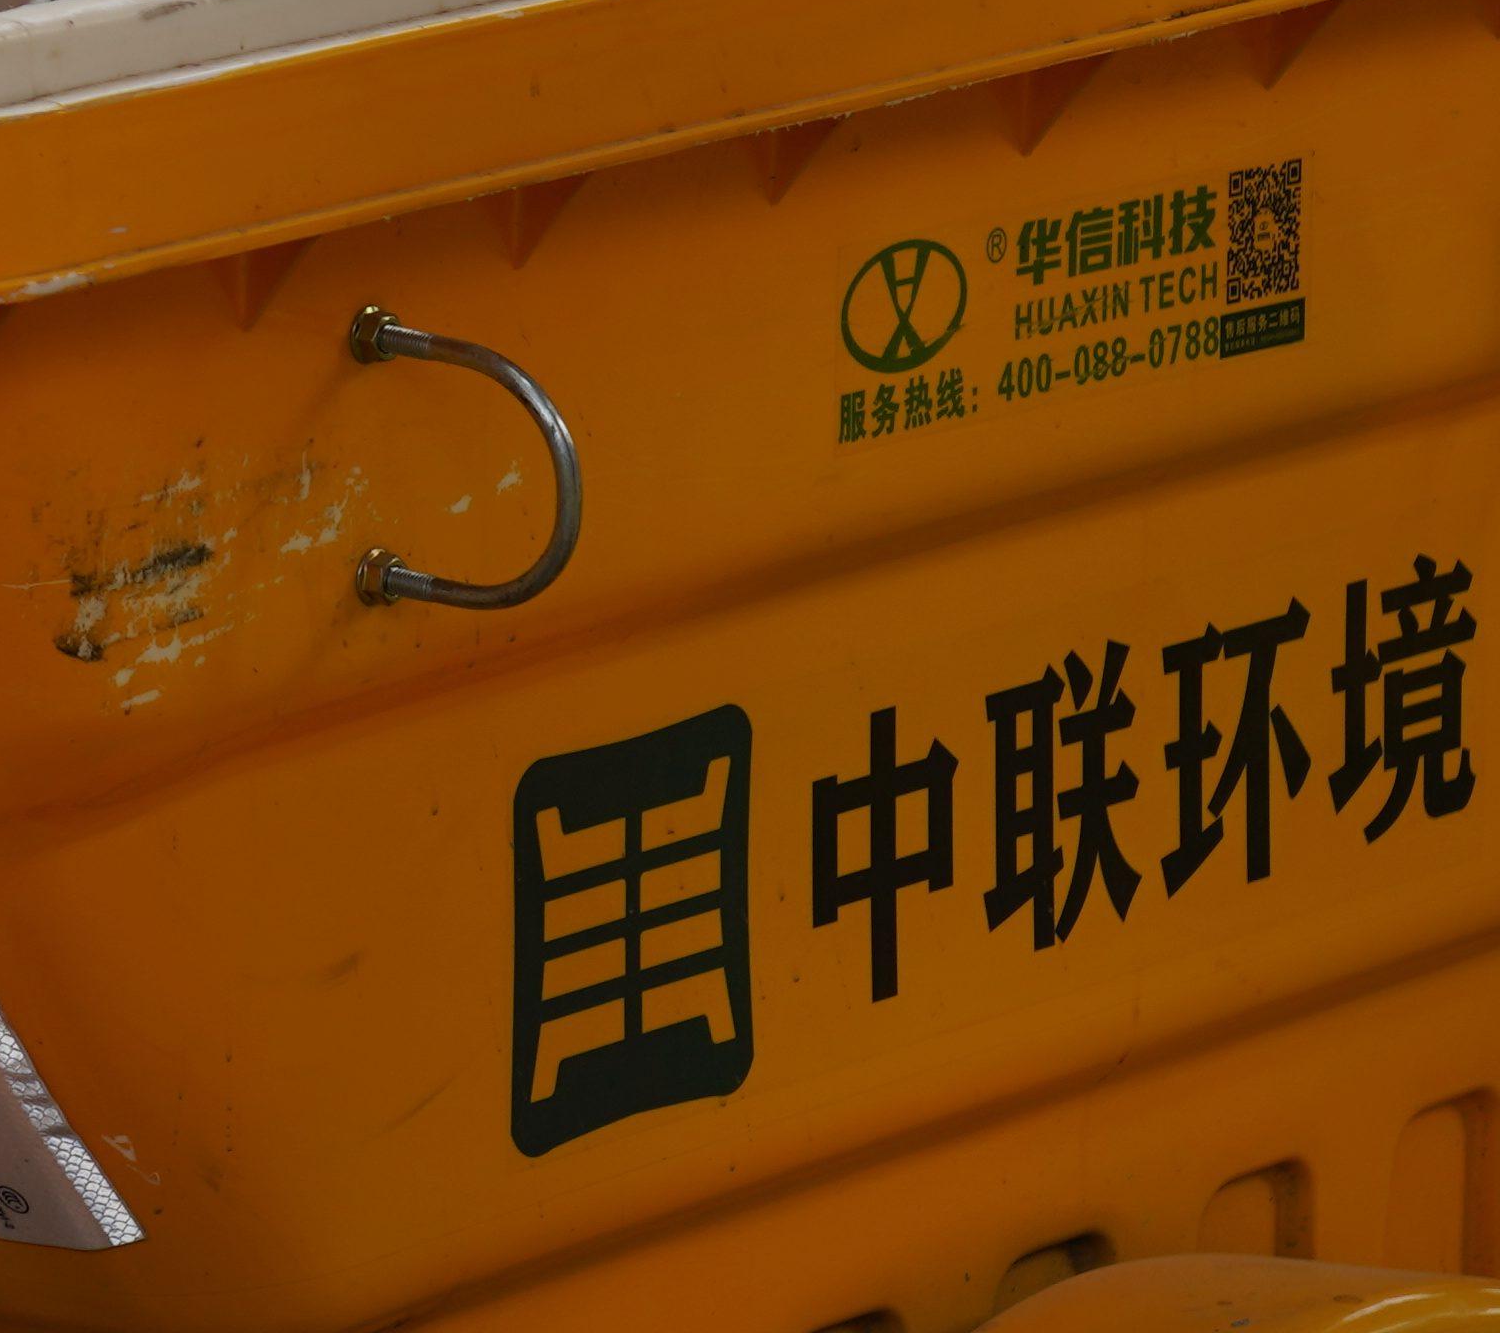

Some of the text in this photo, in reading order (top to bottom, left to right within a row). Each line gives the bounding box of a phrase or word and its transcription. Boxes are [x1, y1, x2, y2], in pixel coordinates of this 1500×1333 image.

[1015, 185, 1218, 286] 华信科技
[1014, 261, 1219, 339] HUAXIN TECH
[999, 316, 1220, 401] 400-088-0788
[811, 552, 1478, 1004] 中联环境
